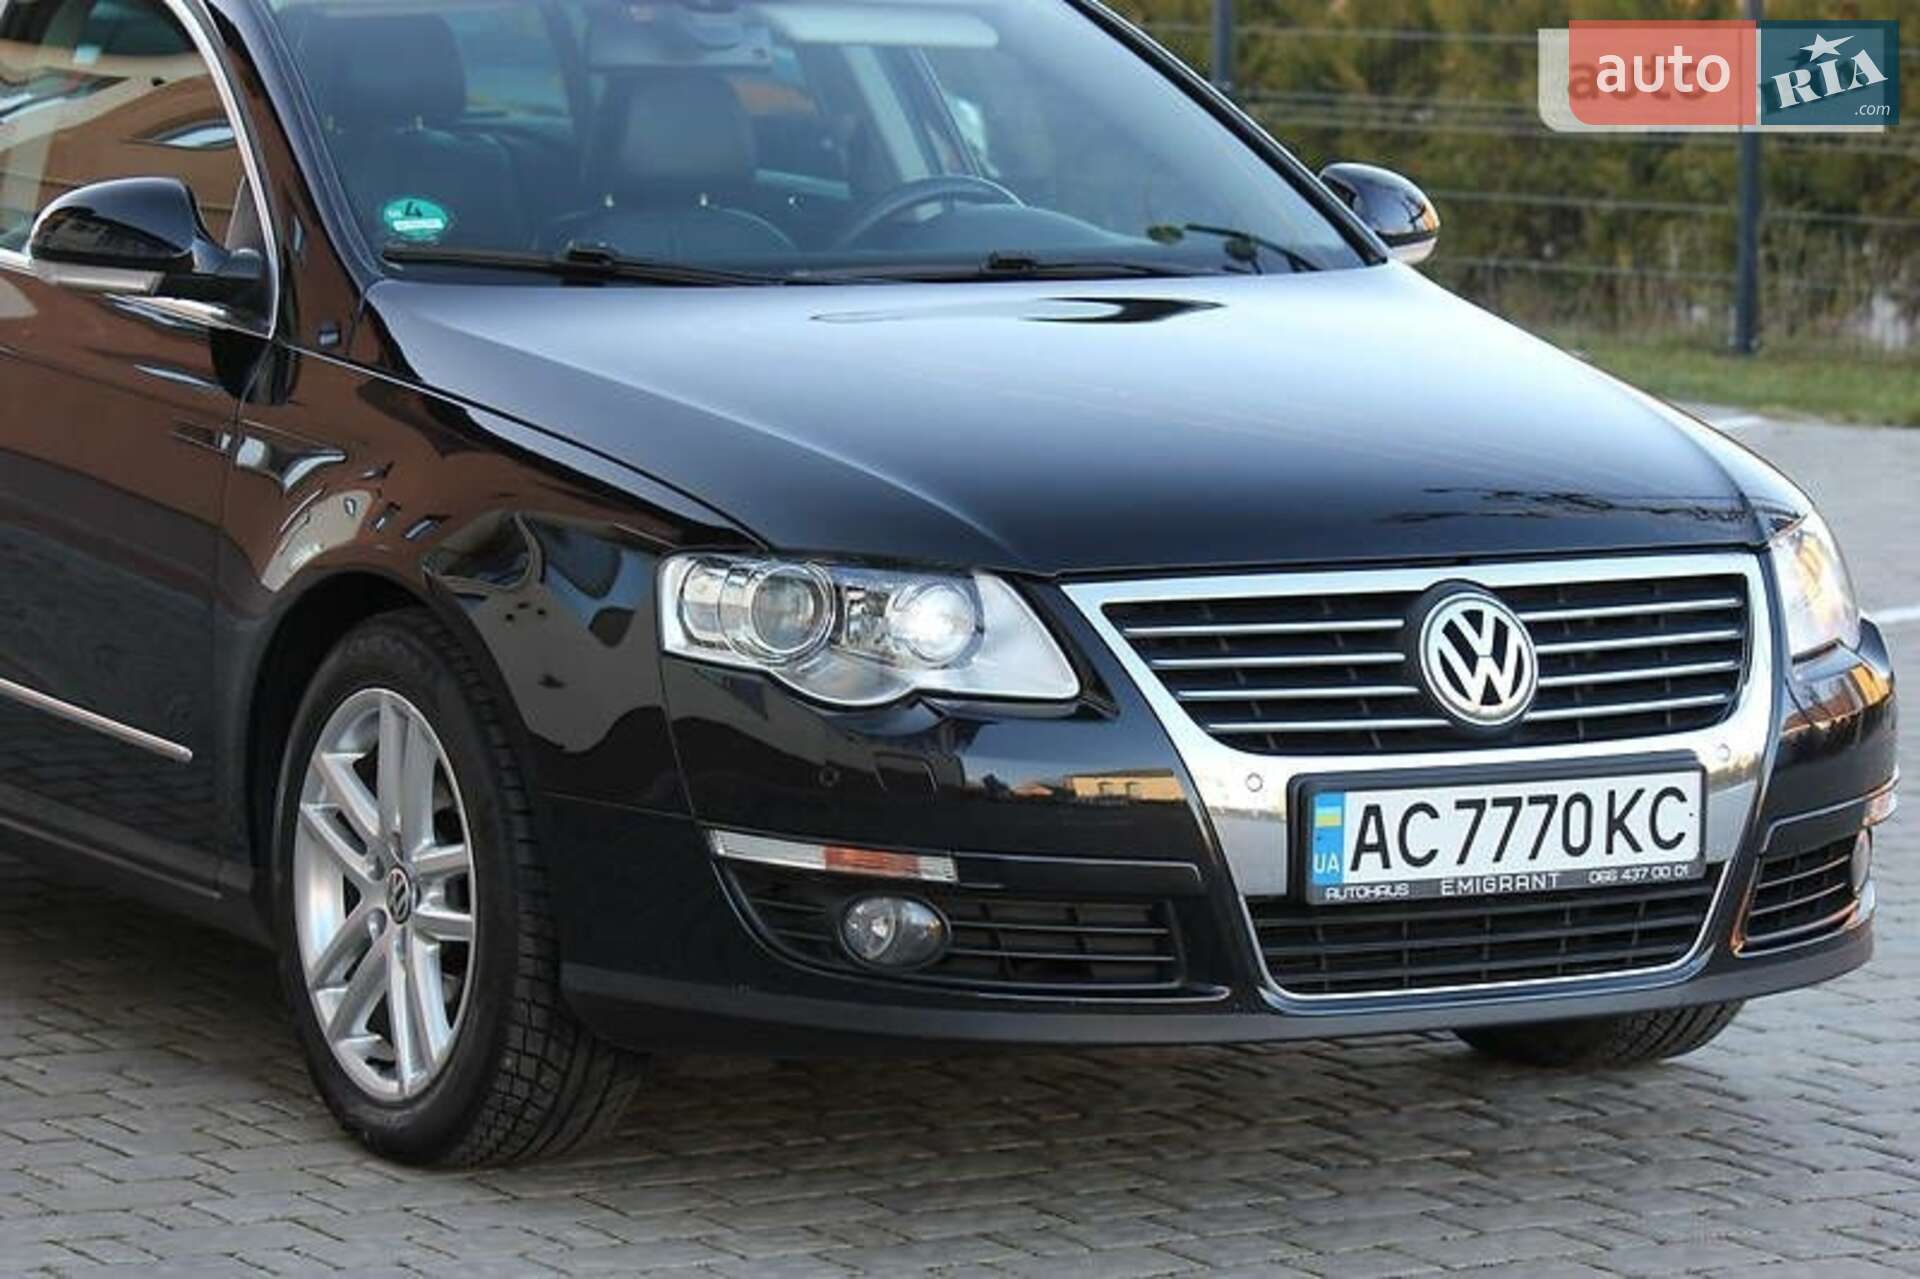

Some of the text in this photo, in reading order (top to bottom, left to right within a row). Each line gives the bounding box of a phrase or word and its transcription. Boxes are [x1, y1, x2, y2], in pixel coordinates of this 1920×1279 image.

[1313, 852, 1340, 874] UA
[1325, 882, 1410, 901] AUTOHAUS
[1441, 872, 1561, 896] EMIGRANT
